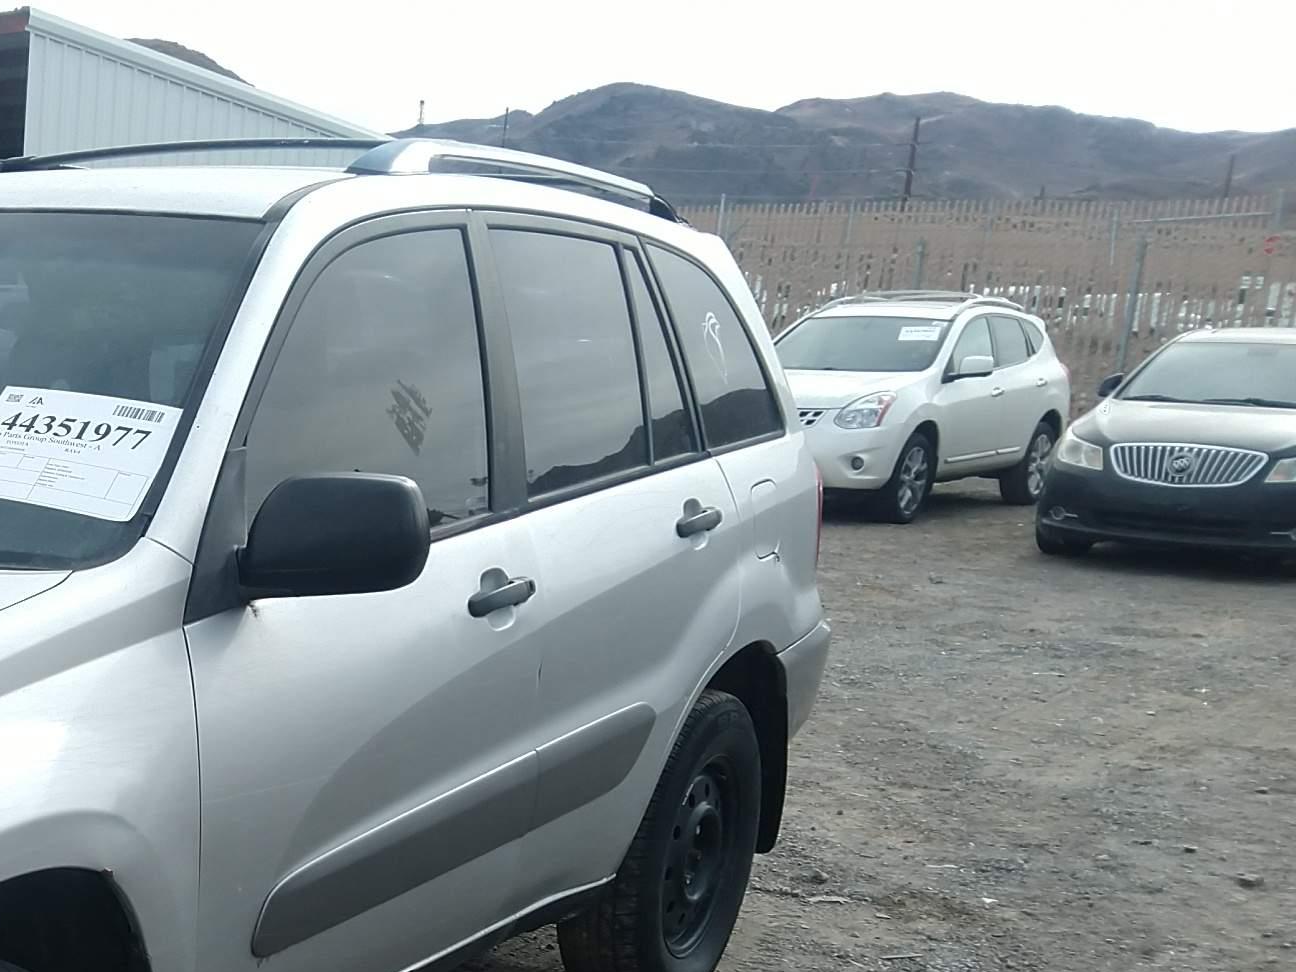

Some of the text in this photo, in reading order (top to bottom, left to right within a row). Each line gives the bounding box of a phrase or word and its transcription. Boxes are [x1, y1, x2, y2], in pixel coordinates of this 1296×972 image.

[0, 411, 153, 450] 44351977
[3, 431, 22, 439] Parts
[23, 434, 47, 444] Group
[48, 436, 88, 449] Southwest
